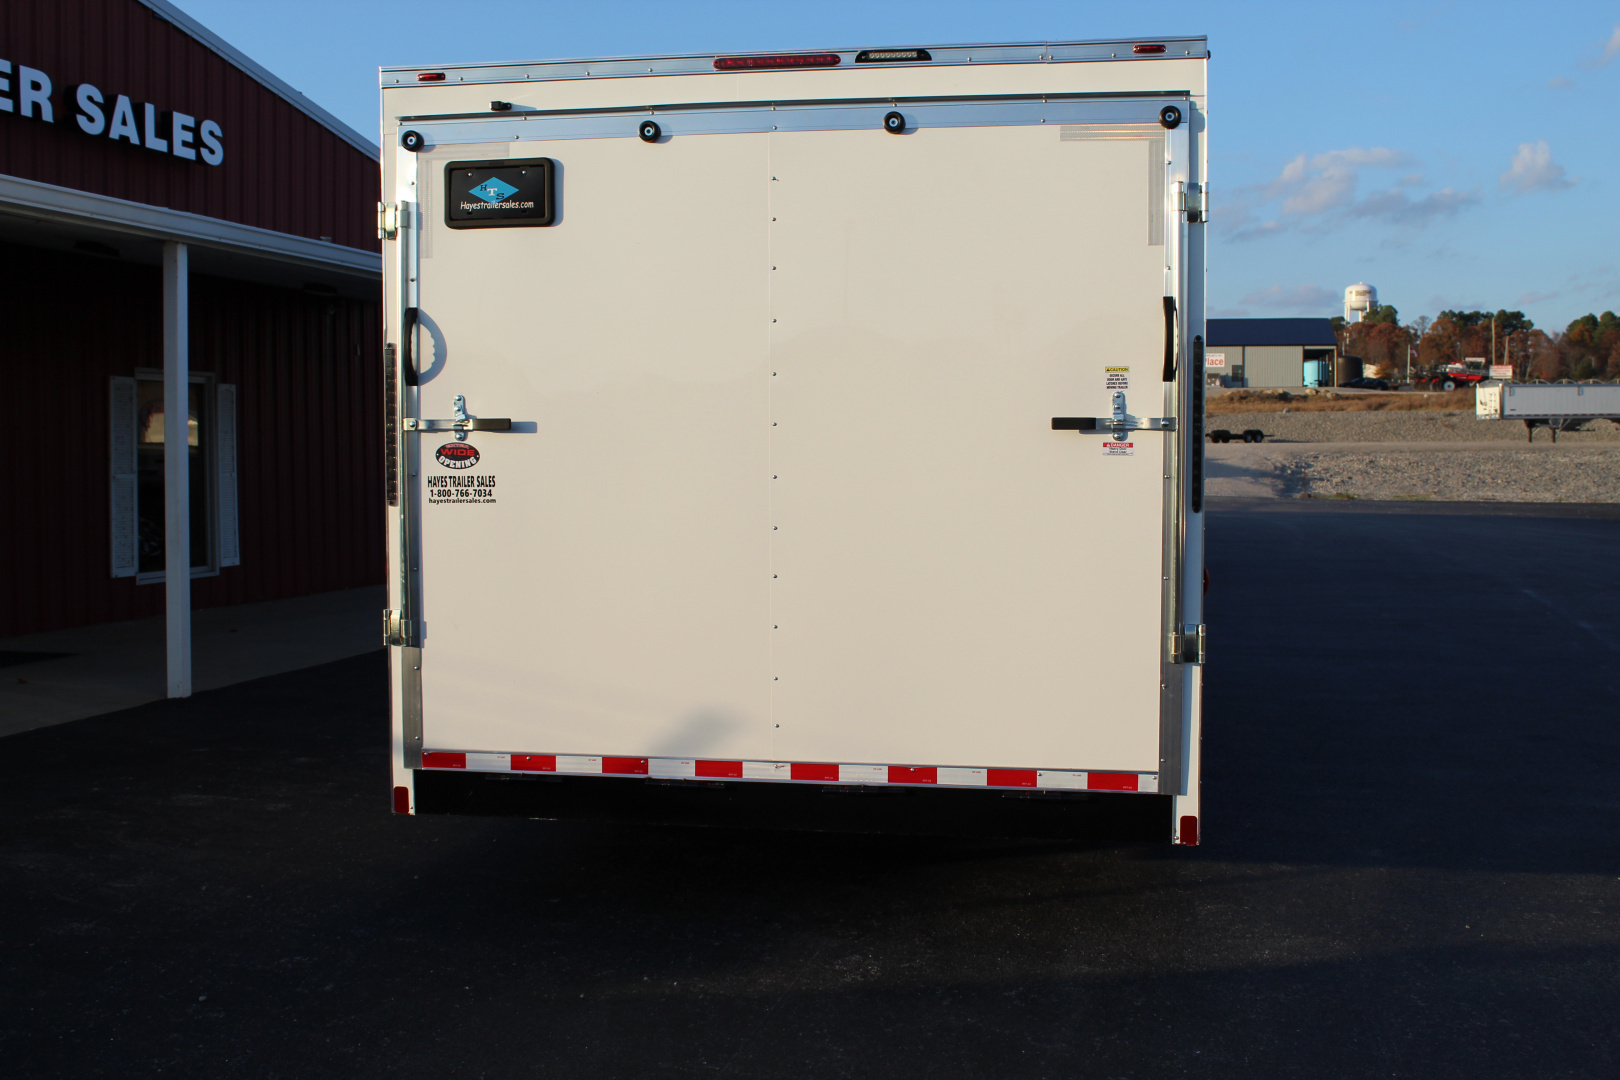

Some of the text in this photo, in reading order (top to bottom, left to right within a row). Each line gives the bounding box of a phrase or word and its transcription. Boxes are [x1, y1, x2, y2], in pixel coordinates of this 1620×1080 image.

[75, 83, 224, 166] SALES
[460, 200, 534, 212] Hayestrailersales.com
[440, 448, 475, 456] WIDE
[438, 455, 477, 469] OPENING
[427, 475, 496, 488] HAYES TRAILER SALES
[429, 488, 492, 498] 1-800-766-7034
